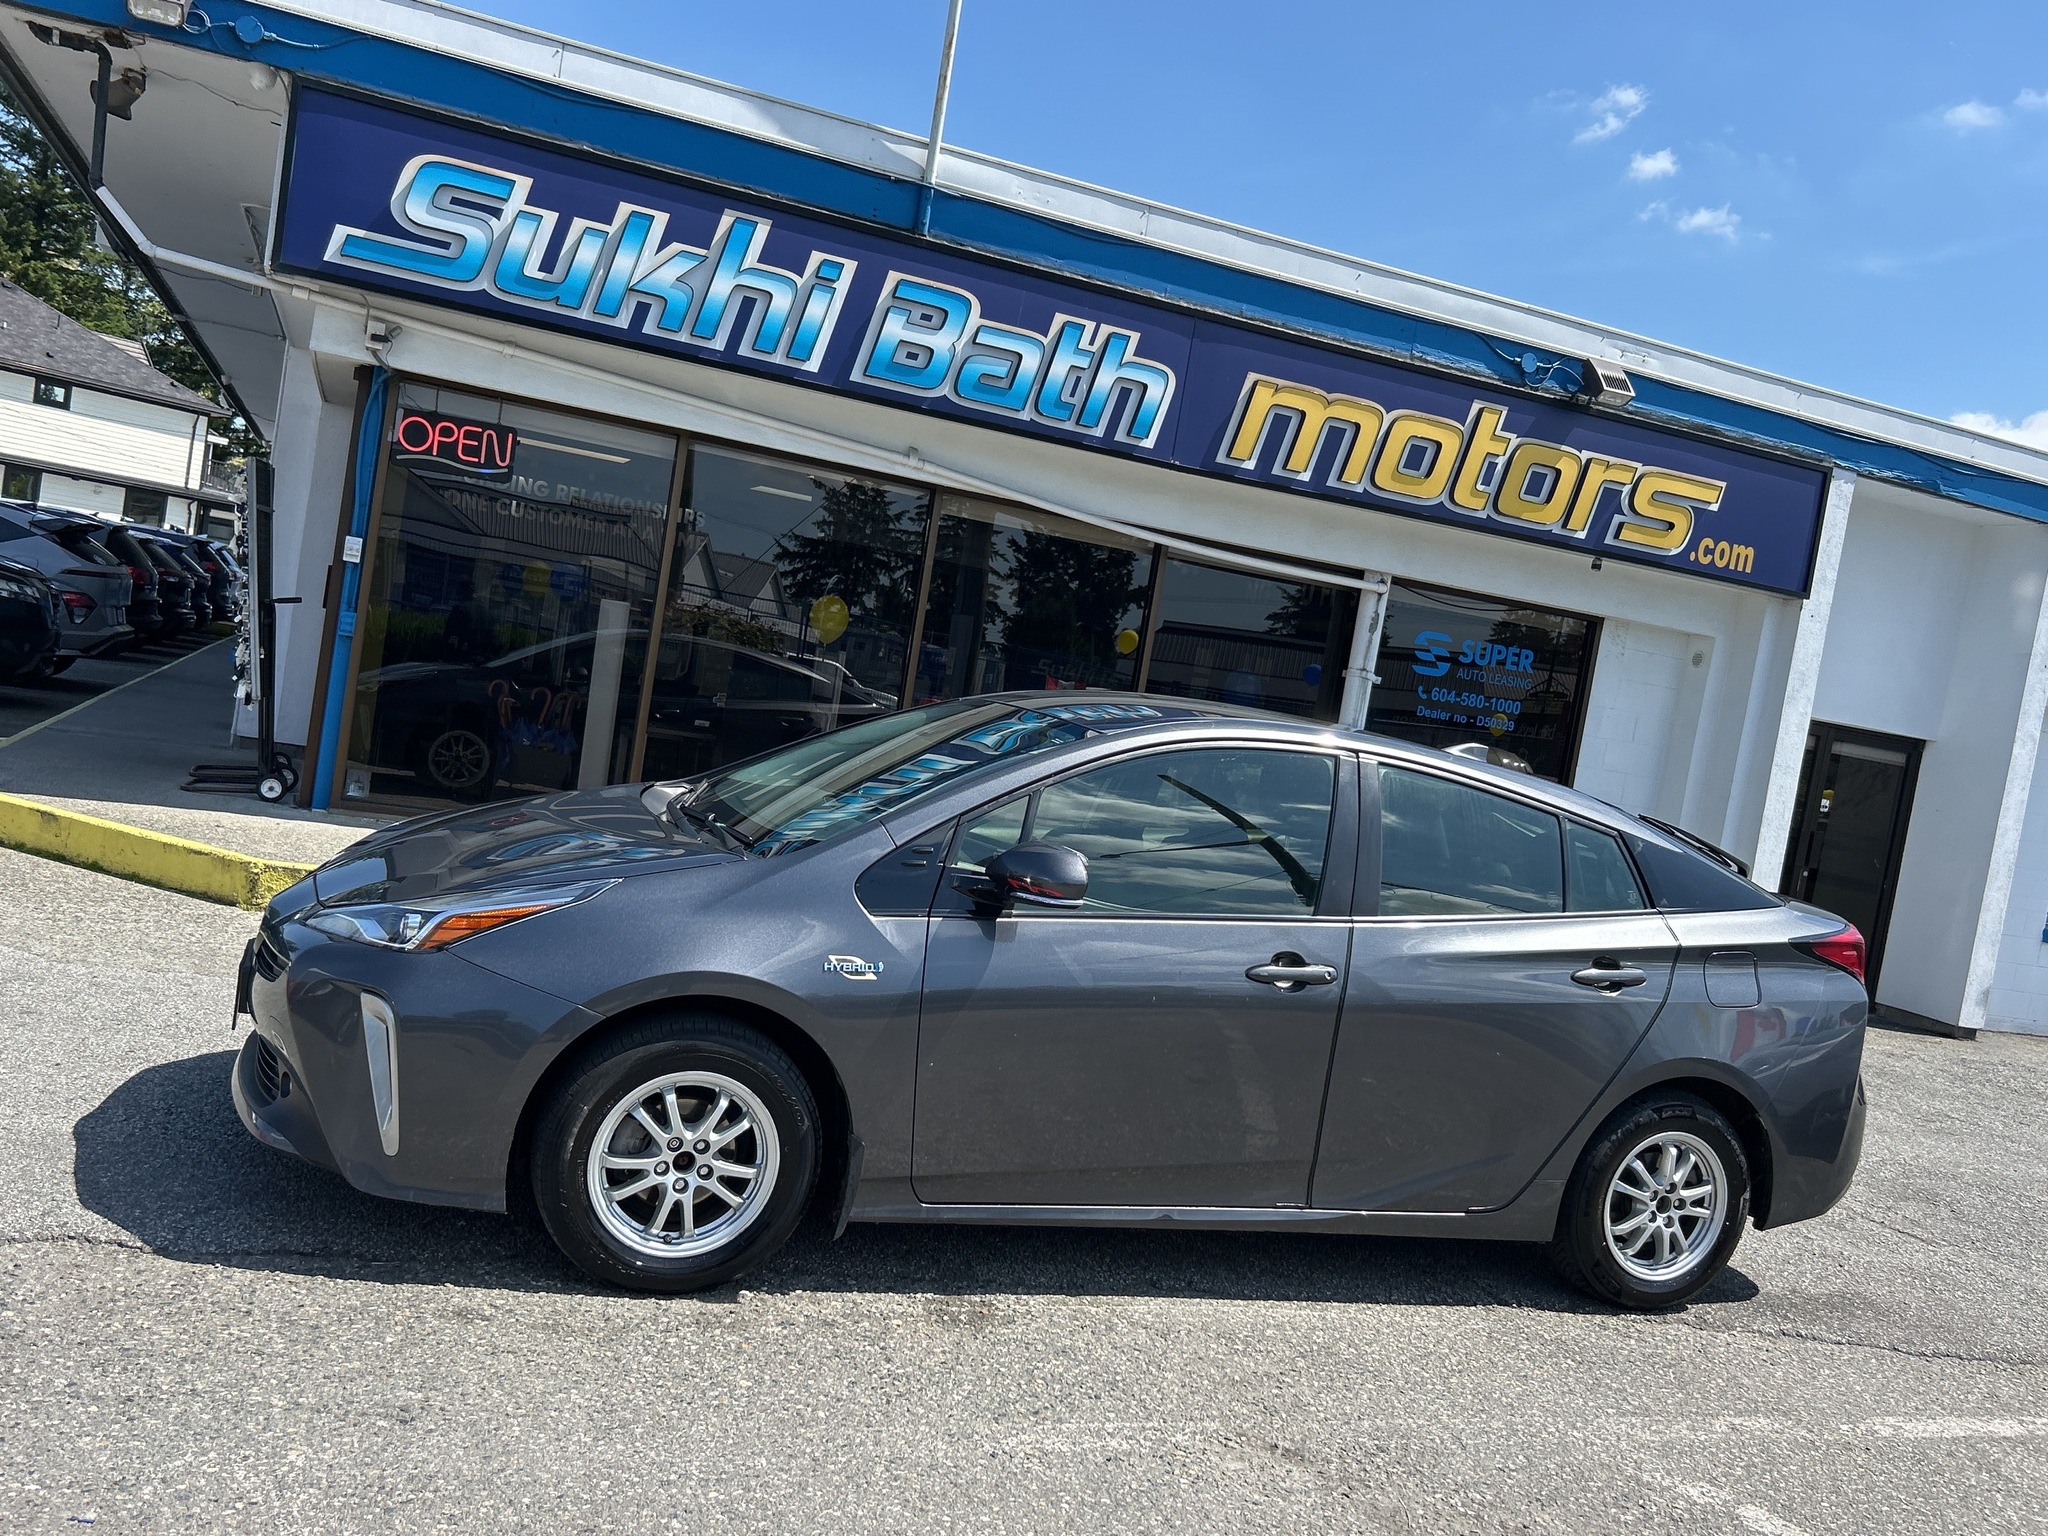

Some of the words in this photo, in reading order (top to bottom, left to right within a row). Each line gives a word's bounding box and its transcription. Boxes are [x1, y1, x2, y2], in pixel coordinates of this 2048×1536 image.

[323, 154, 858, 373] Sukhi
[849, 270, 1176, 449] Bath
[1215, 371, 1727, 556] motors
[398, 416, 513, 467] OPEN
[1458, 639, 1534, 674] SUPER
[1456, 668, 1487, 683] AUTO
[1488, 674, 1533, 690] LEASING
[1431, 687, 1521, 715] 604-580-1000
[1416, 705, 1451, 721] Dealer
[1453, 714, 1467, 724] no
[1476, 715, 1515, 732] D50329
[824, 961, 876, 972] HYBRID
